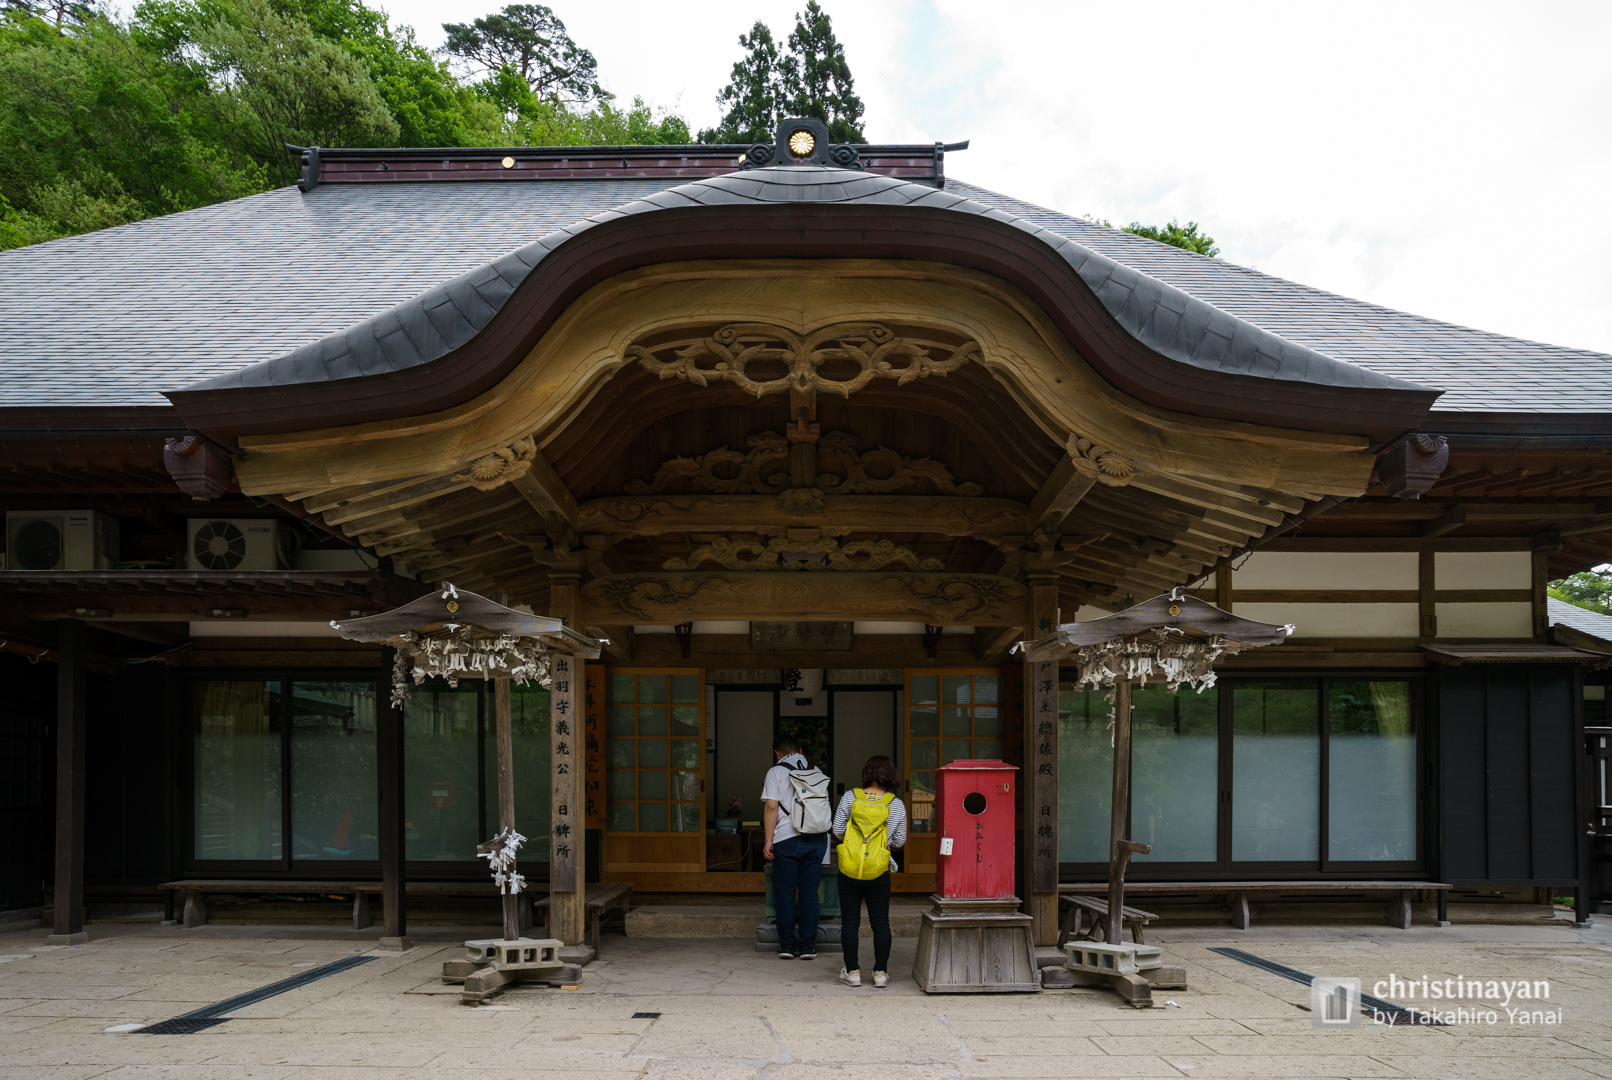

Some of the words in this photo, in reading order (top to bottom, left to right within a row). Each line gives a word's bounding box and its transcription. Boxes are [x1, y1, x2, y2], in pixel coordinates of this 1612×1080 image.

[555, 617, 571, 775] 出羽守義光公
[1038, 617, 1054, 776] 新戸澤上總佐殿
[975, 821, 984, 863] おみくじ
